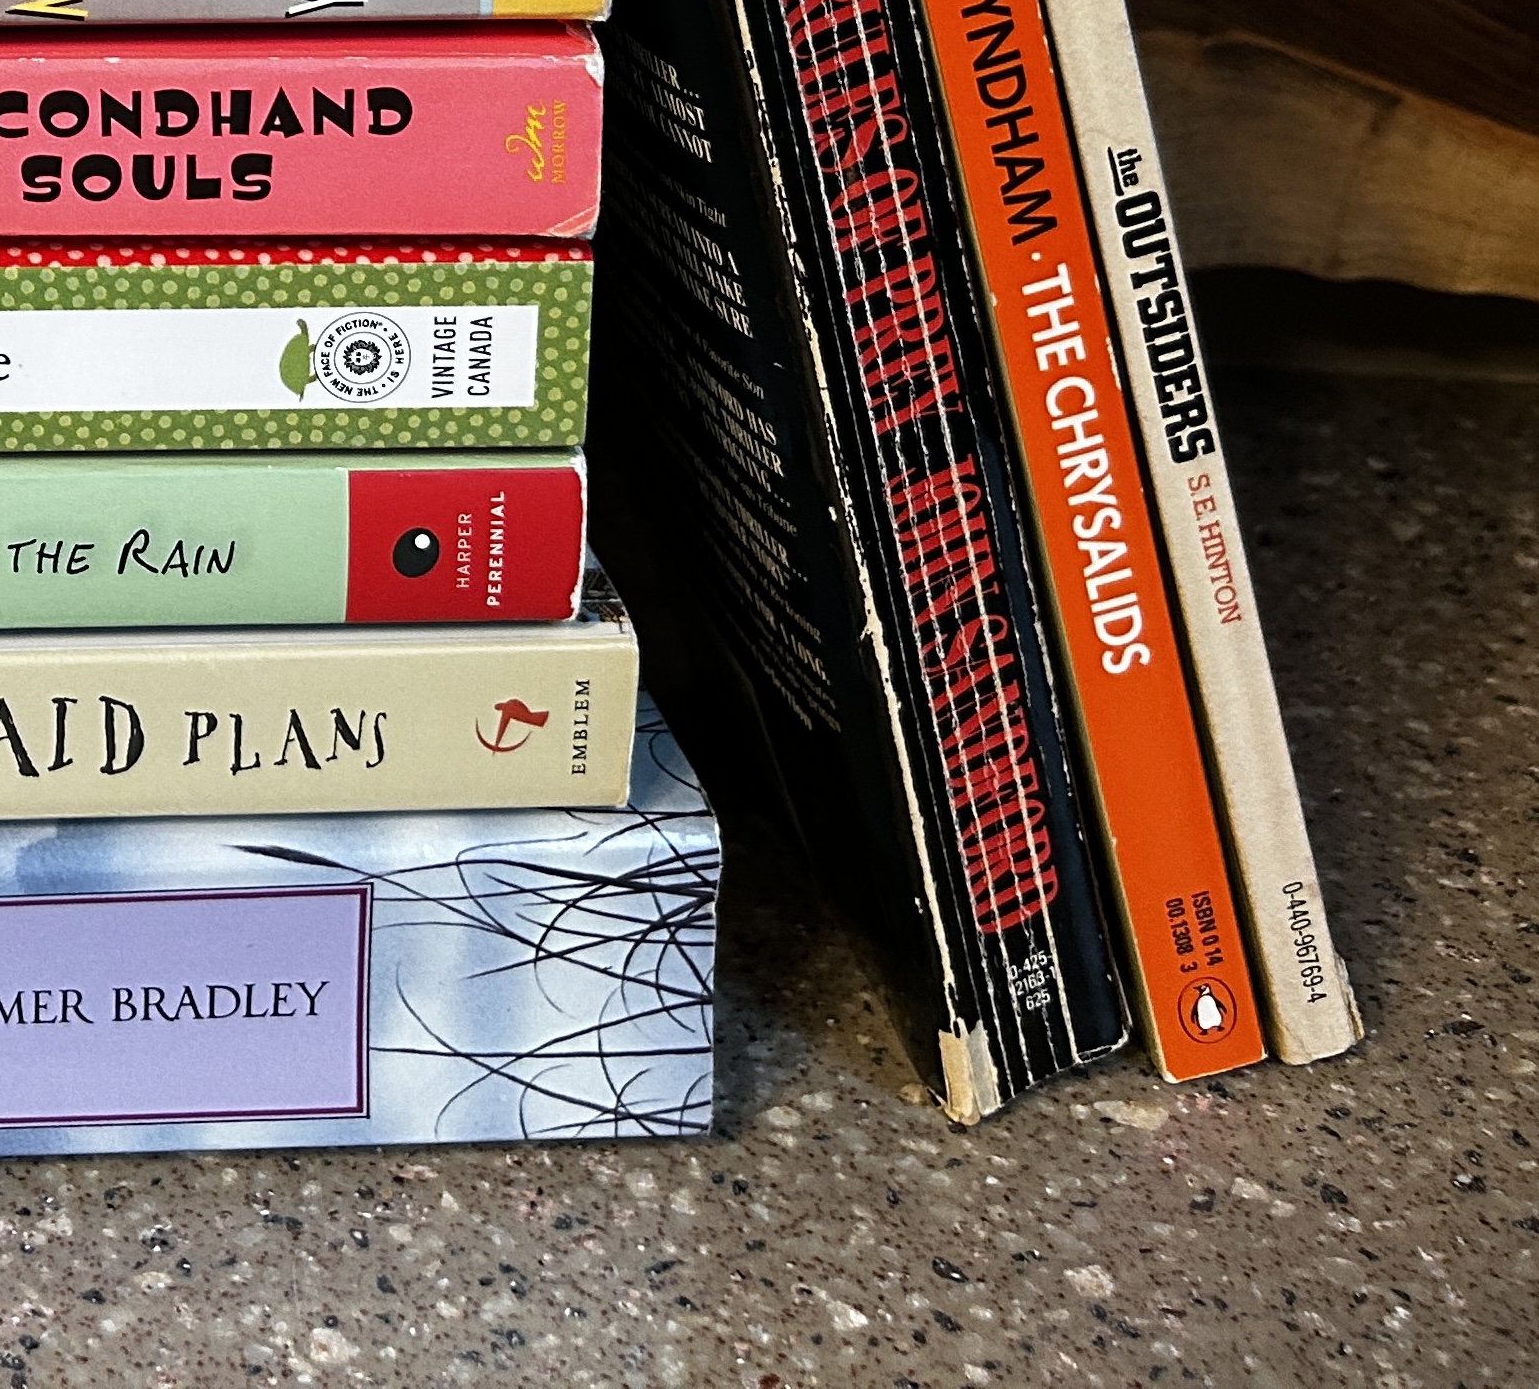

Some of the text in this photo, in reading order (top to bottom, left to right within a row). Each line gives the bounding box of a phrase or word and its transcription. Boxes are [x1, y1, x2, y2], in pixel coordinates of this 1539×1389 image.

[21, 152, 275, 202] SOULS
[551, 98, 567, 184] MORROW
[1107, 147, 1143, 198] the
[831, 168, 929, 255] OF
[324, 333, 336, 348] OF
[386, 332, 405, 383] IS HERE
[432, 314, 457, 399] VINTAGE
[467, 314, 494, 397] CANADA
[845, 250, 963, 436] PREY
[1021, 263, 1089, 372] THE
[1116, 191, 1217, 464] OUTSIDERS
[320, 351, 334, 377] FACE
[329, 377, 354, 395] NEW
[356, 385, 379, 397] THE
[8, 540, 93, 575] THE
[116, 529, 237, 577] RAIN
[456, 511, 473, 589] HARPER
[486, 489, 507, 607] PERENNIAL
[885, 453, 1000, 628] JOHN
[1045, 376, 1153, 676] CHRYSALIDS
[1198, 519, 1243, 625] HINTON
[182, 708, 388, 775] PLANS
[572, 677, 591, 775] EMBLEM
[920, 614, 1059, 935] SANDFORD
[1165, 897, 1198, 973] 00.1308 3
[1191, 890, 1224, 966] ISBN 0 14
[1282, 881, 1318, 1004] 0-440-96769-4
[111, 980, 330, 1023] BRADLEY
[1026, 988, 1051, 1011] 625
